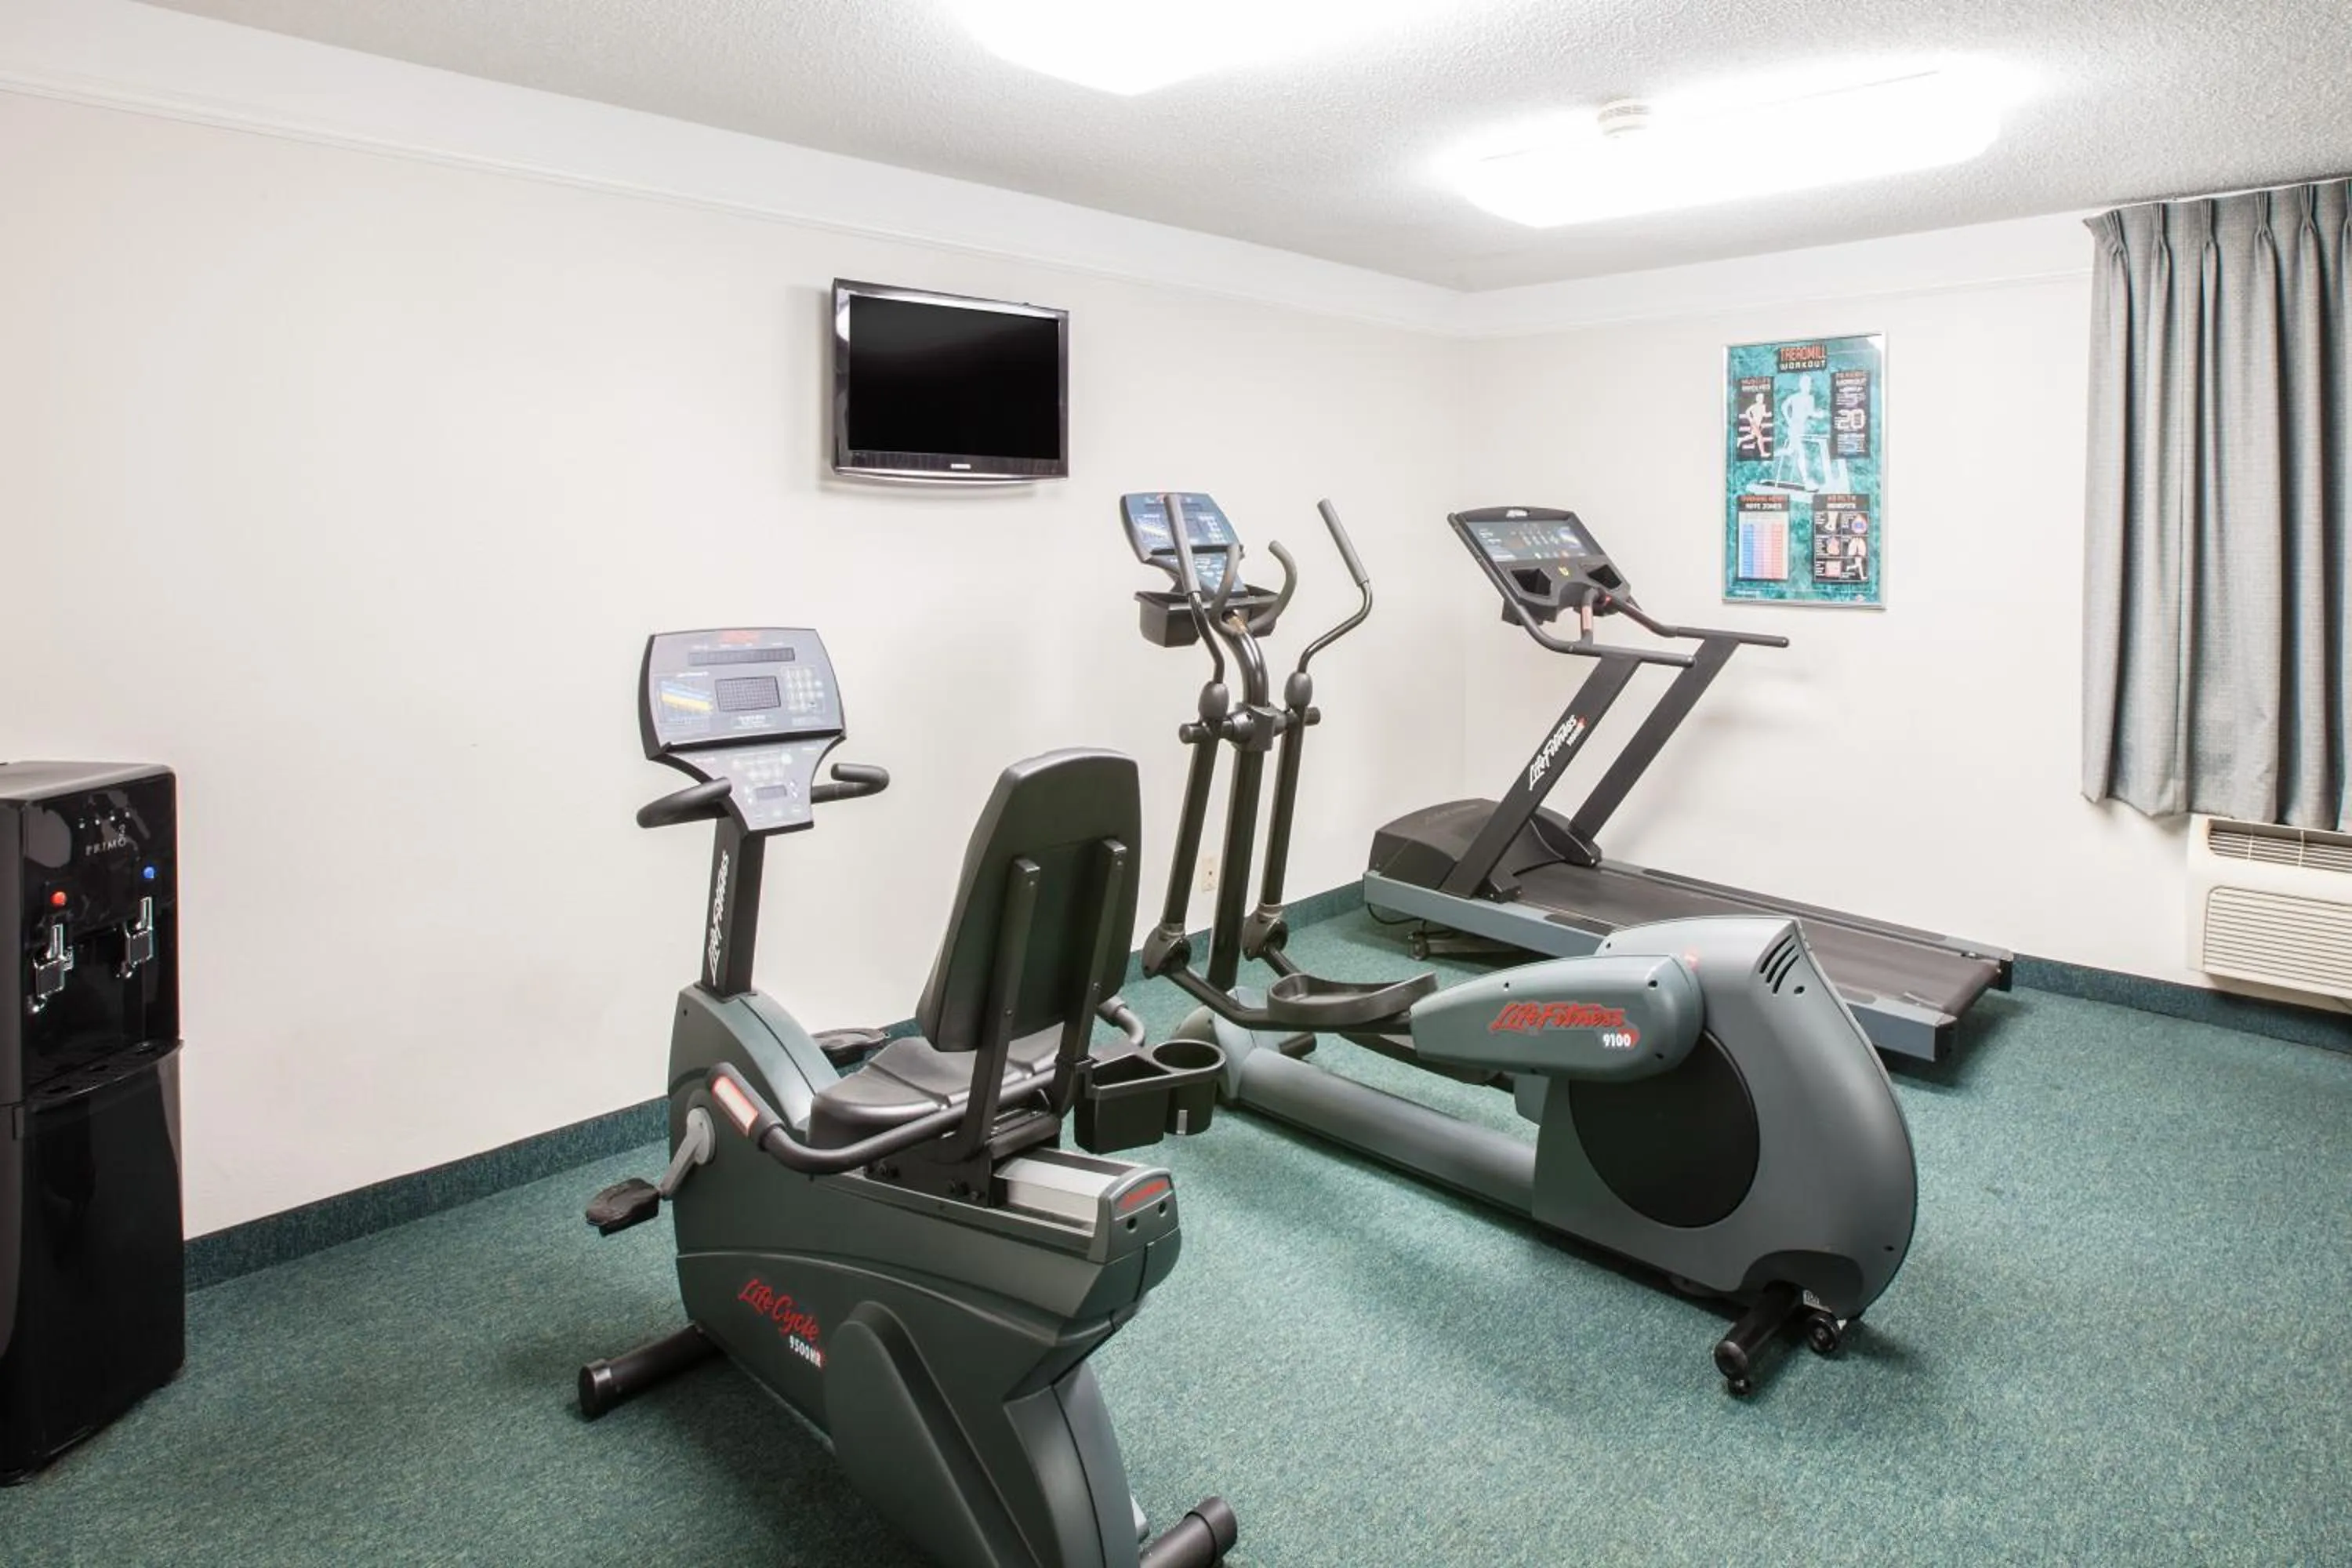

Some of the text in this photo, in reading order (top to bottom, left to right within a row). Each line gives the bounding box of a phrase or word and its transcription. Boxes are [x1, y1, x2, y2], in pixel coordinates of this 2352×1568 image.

[1780, 360, 1826, 370] WORKOUT
[85, 839, 126, 856] PRIMO
[1602, 1033, 1632, 1047] 9100
